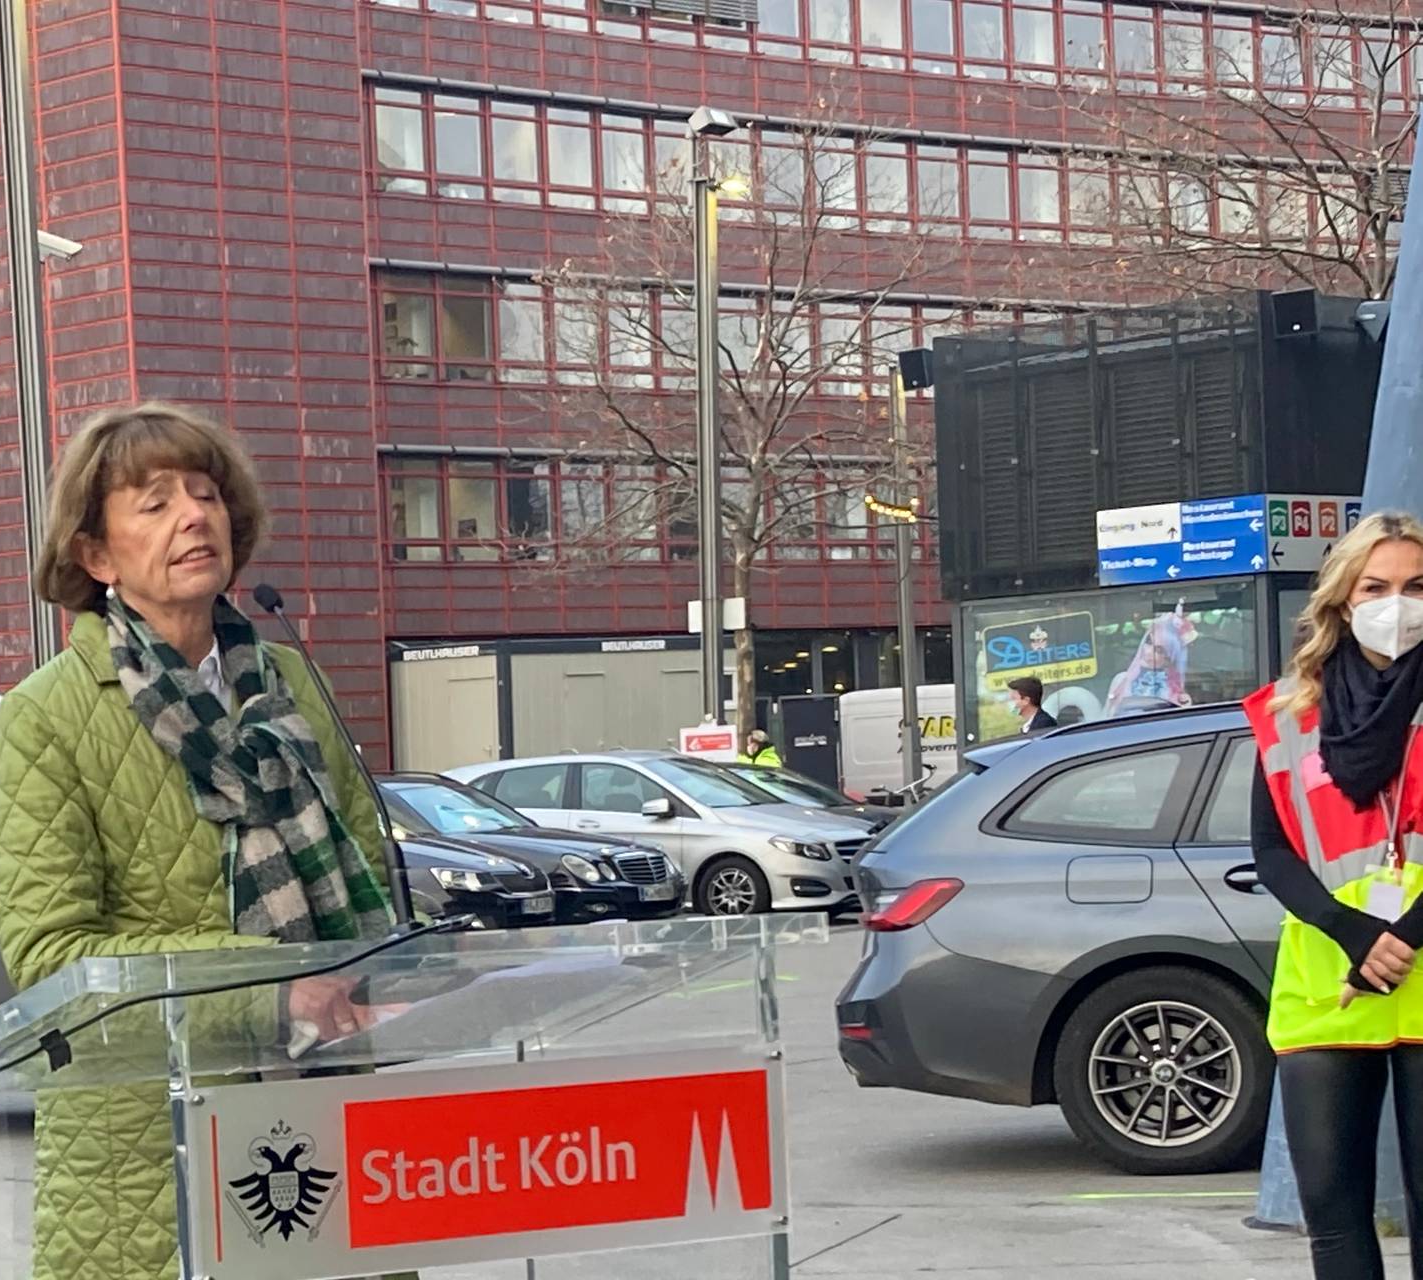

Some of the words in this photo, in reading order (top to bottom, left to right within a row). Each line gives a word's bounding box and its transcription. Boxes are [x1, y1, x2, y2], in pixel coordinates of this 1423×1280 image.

[1141, 519, 1163, 528] Nord
[1271, 515, 1287, 532] P3
[1294, 515, 1309, 532] P4
[1320, 515, 1336, 532] P2
[1182, 539, 1237, 551] Restaurant
[1101, 557, 1157, 570] Ticket-Shop
[1183, 550, 1234, 563] Backstage
[362, 1136, 507, 1204] Stadt
[519, 1126, 637, 1190] Köln
